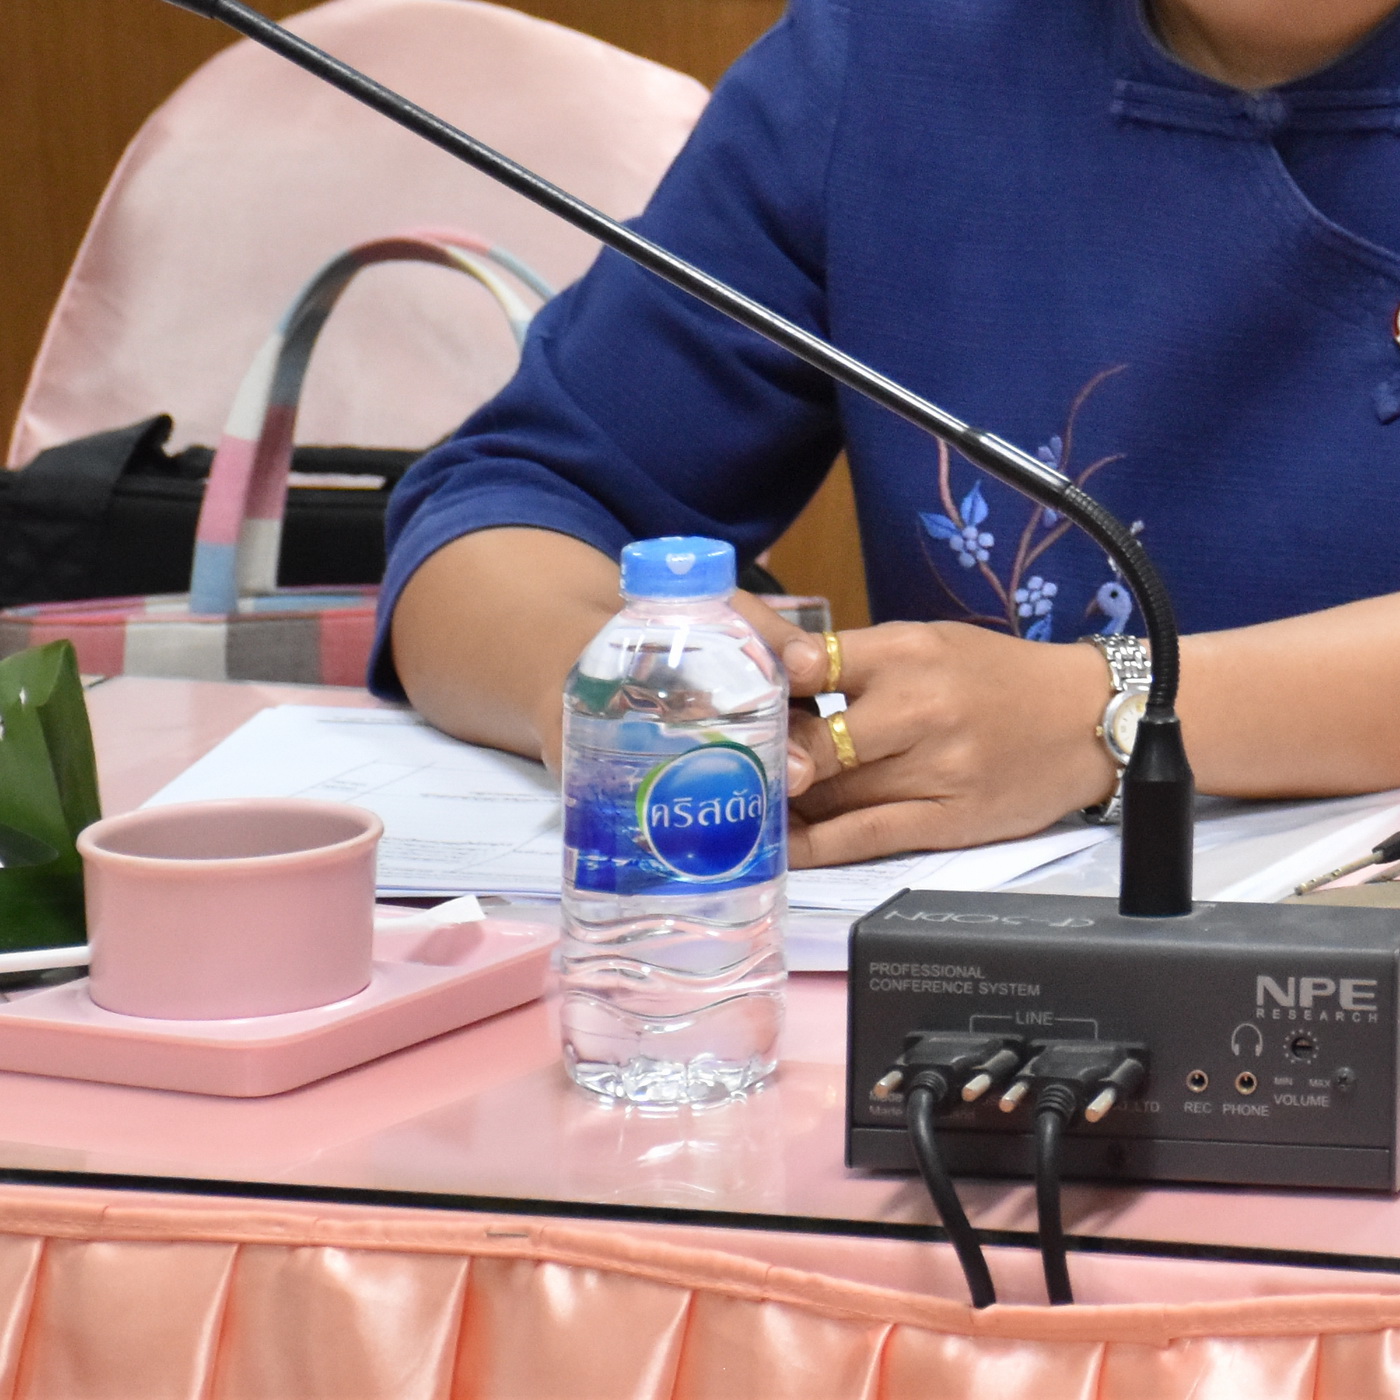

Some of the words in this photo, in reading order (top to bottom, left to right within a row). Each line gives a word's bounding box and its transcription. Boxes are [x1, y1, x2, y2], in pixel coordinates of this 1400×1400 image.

[651, 789, 762, 828] คริสตัล
[869, 962, 986, 979] PROFESSIONAL
[869, 978, 973, 994] CONFERENCE
[978, 982, 1040, 996] SYSTEM
[1256, 975, 1378, 1011] NPE
[1015, 1011, 1054, 1026] LINE
[1256, 1009, 1378, 1023] RESEARCH
[1274, 1076, 1293, 1086] MIN
[1309, 1078, 1331, 1088] MAX
[1184, 1102, 1212, 1114] REC
[1274, 1094, 1330, 1108] VOLUME
[1222, 1103, 1269, 1117] PHONE
